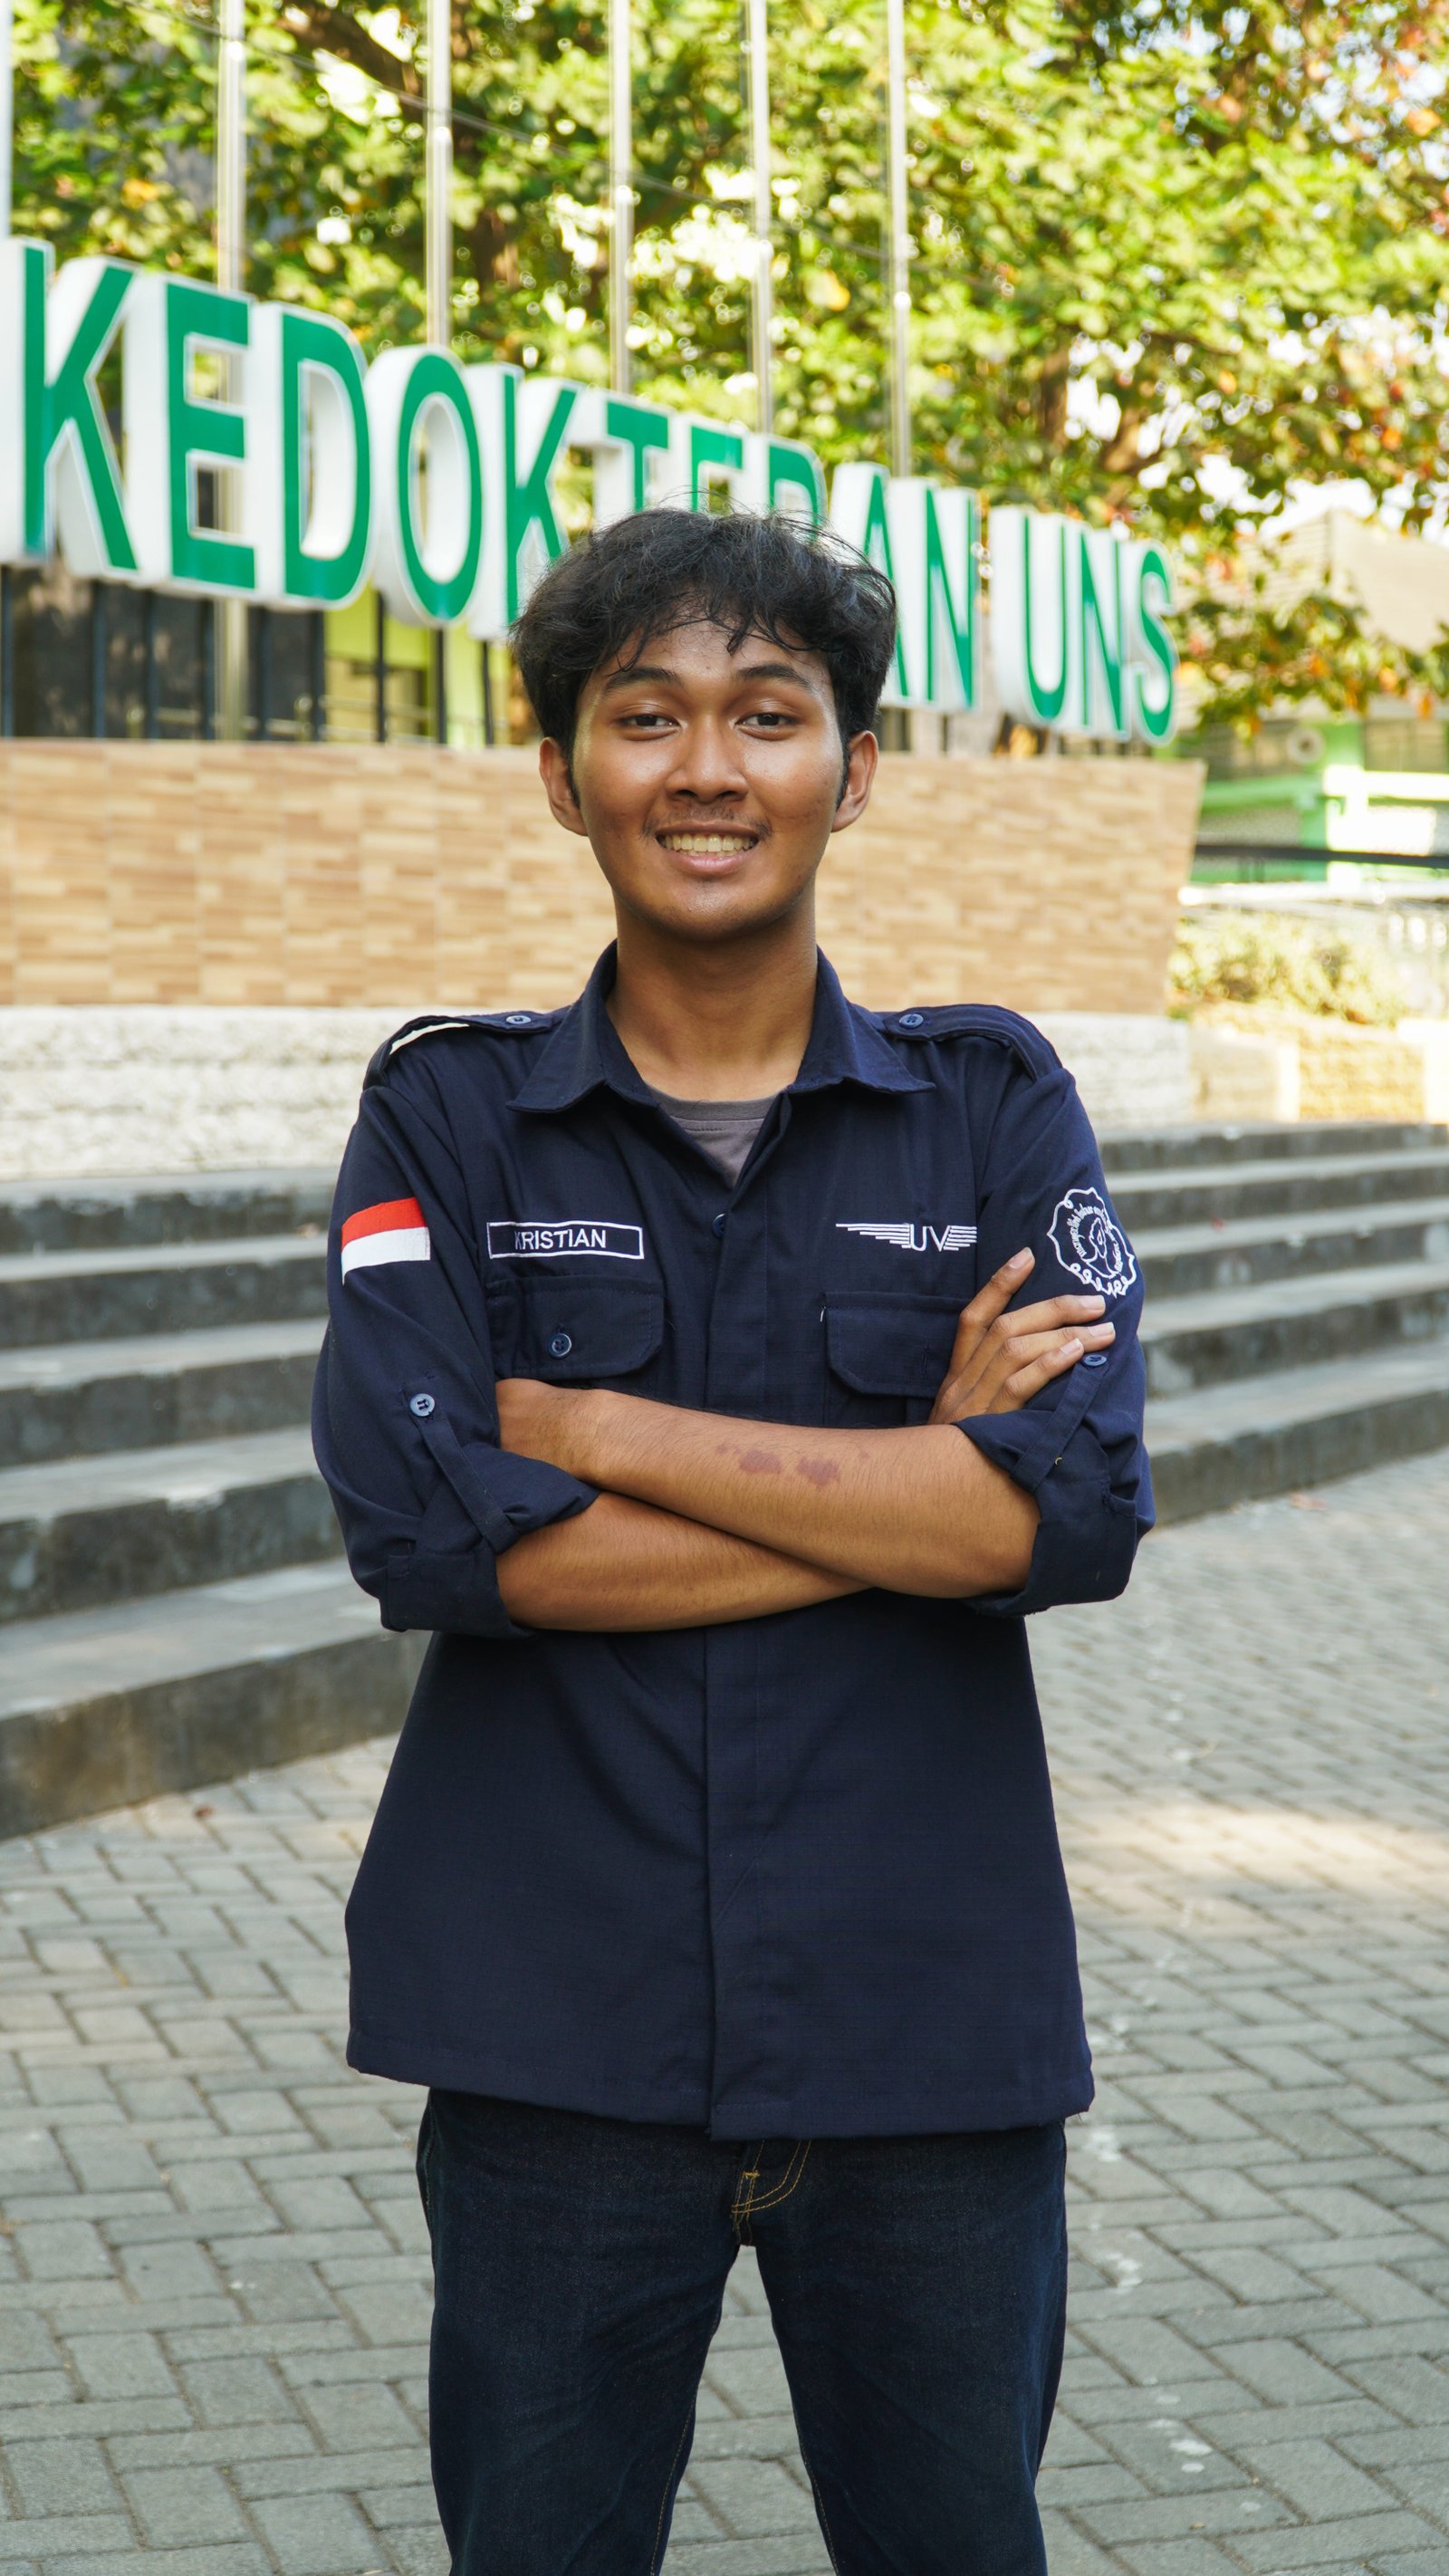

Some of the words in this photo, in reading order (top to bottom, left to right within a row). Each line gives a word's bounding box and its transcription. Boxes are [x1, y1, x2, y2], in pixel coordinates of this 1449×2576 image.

[1003, 507, 1178, 743] UNS
[514, 1228, 607, 1250] KRISTIAN
[910, 1224, 951, 1252] UV
